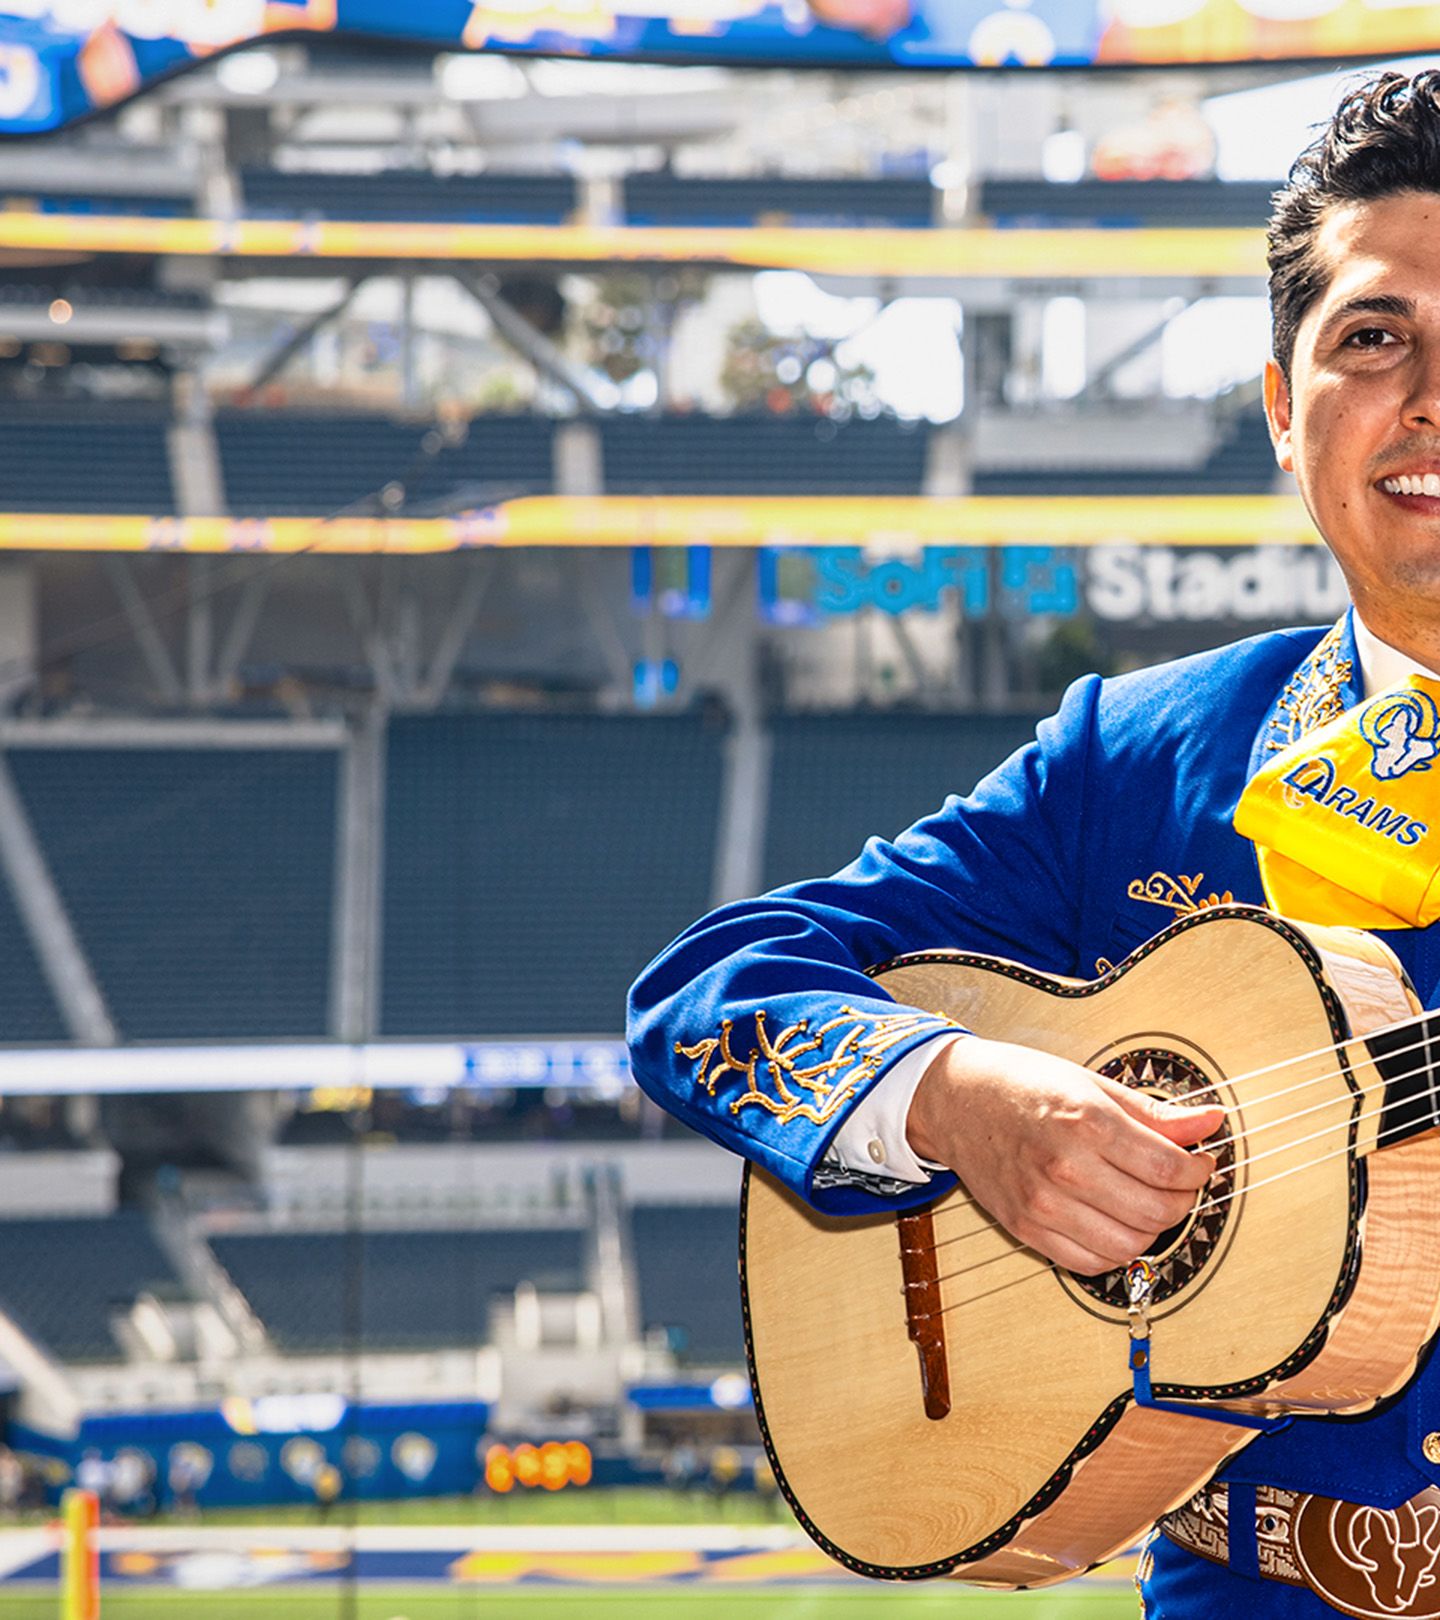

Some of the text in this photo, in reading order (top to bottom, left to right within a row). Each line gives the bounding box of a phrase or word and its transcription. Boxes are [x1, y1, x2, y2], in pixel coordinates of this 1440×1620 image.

[813, 540, 1350, 620] SoFi Stadiu
[1323, 786, 1429, 846] RAMS
